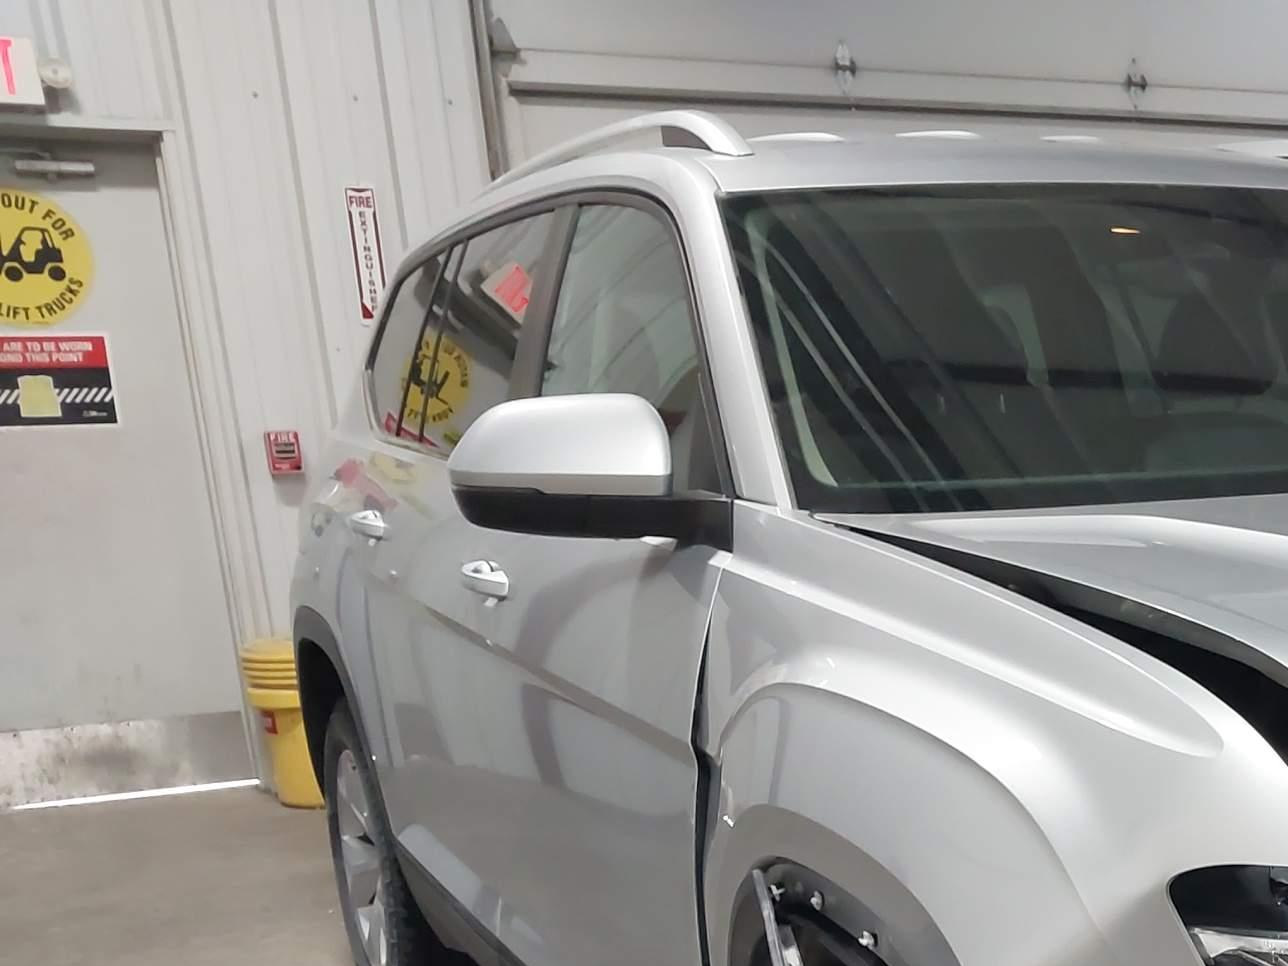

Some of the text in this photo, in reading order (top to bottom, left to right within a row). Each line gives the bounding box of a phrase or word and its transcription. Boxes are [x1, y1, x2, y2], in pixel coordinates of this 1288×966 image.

[1, 193, 75, 241] OUT FOR
[348, 195, 372, 208] FIRE
[359, 210, 378, 313] EXTINGUISHER
[0, 277, 83, 320] LIFT TRUCKS
[25, 342, 41, 352] TO
